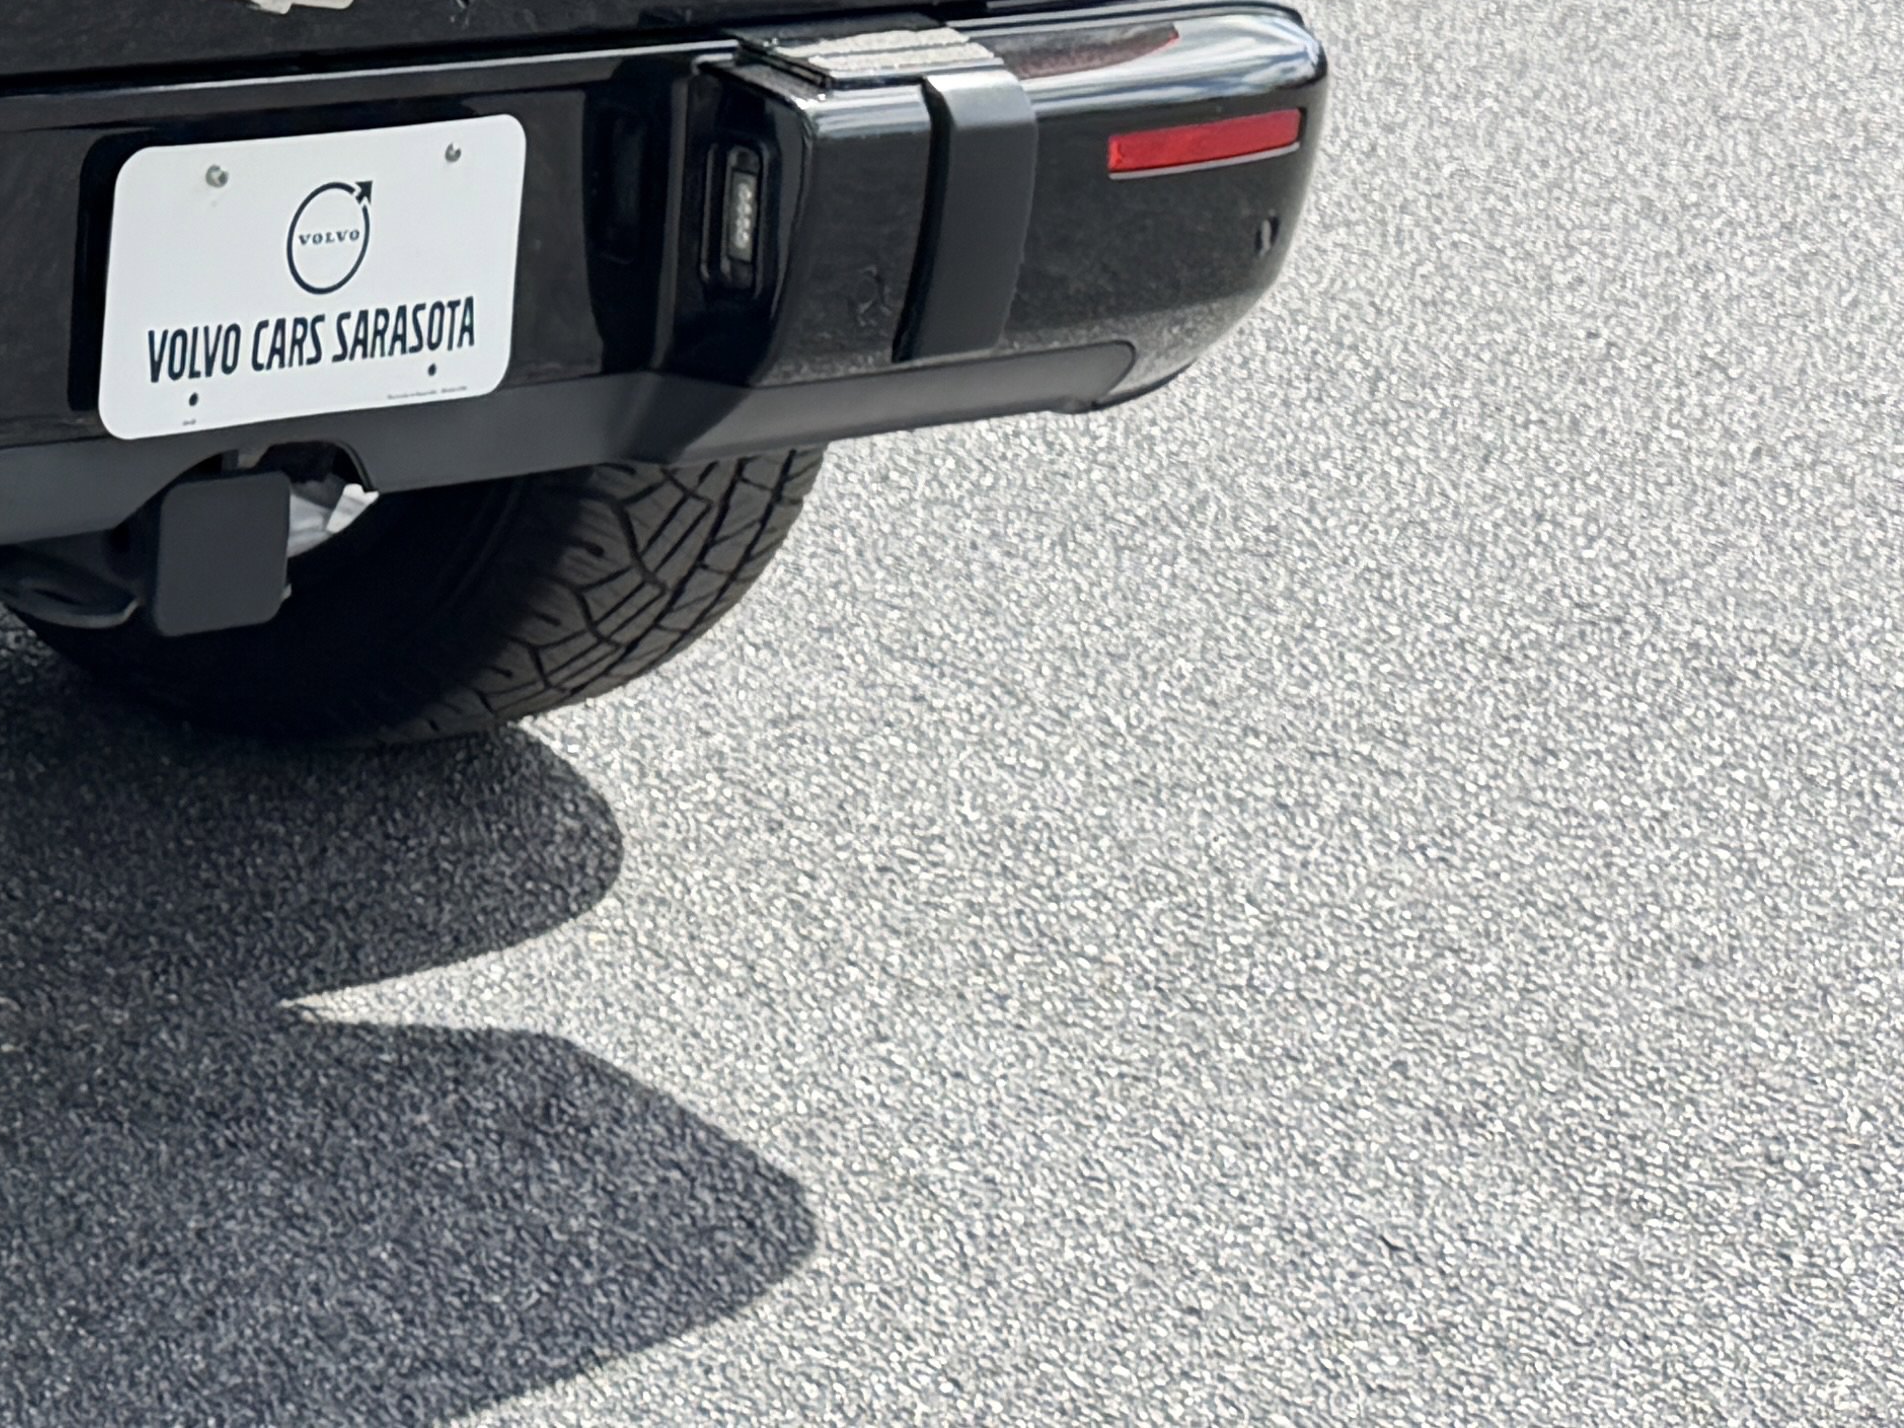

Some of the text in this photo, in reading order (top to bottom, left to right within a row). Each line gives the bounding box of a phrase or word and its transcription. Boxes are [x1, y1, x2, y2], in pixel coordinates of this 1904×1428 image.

[298, 228, 360, 245] VOLVO
[147, 295, 476, 383] VOLVO CARS SARASOTA
